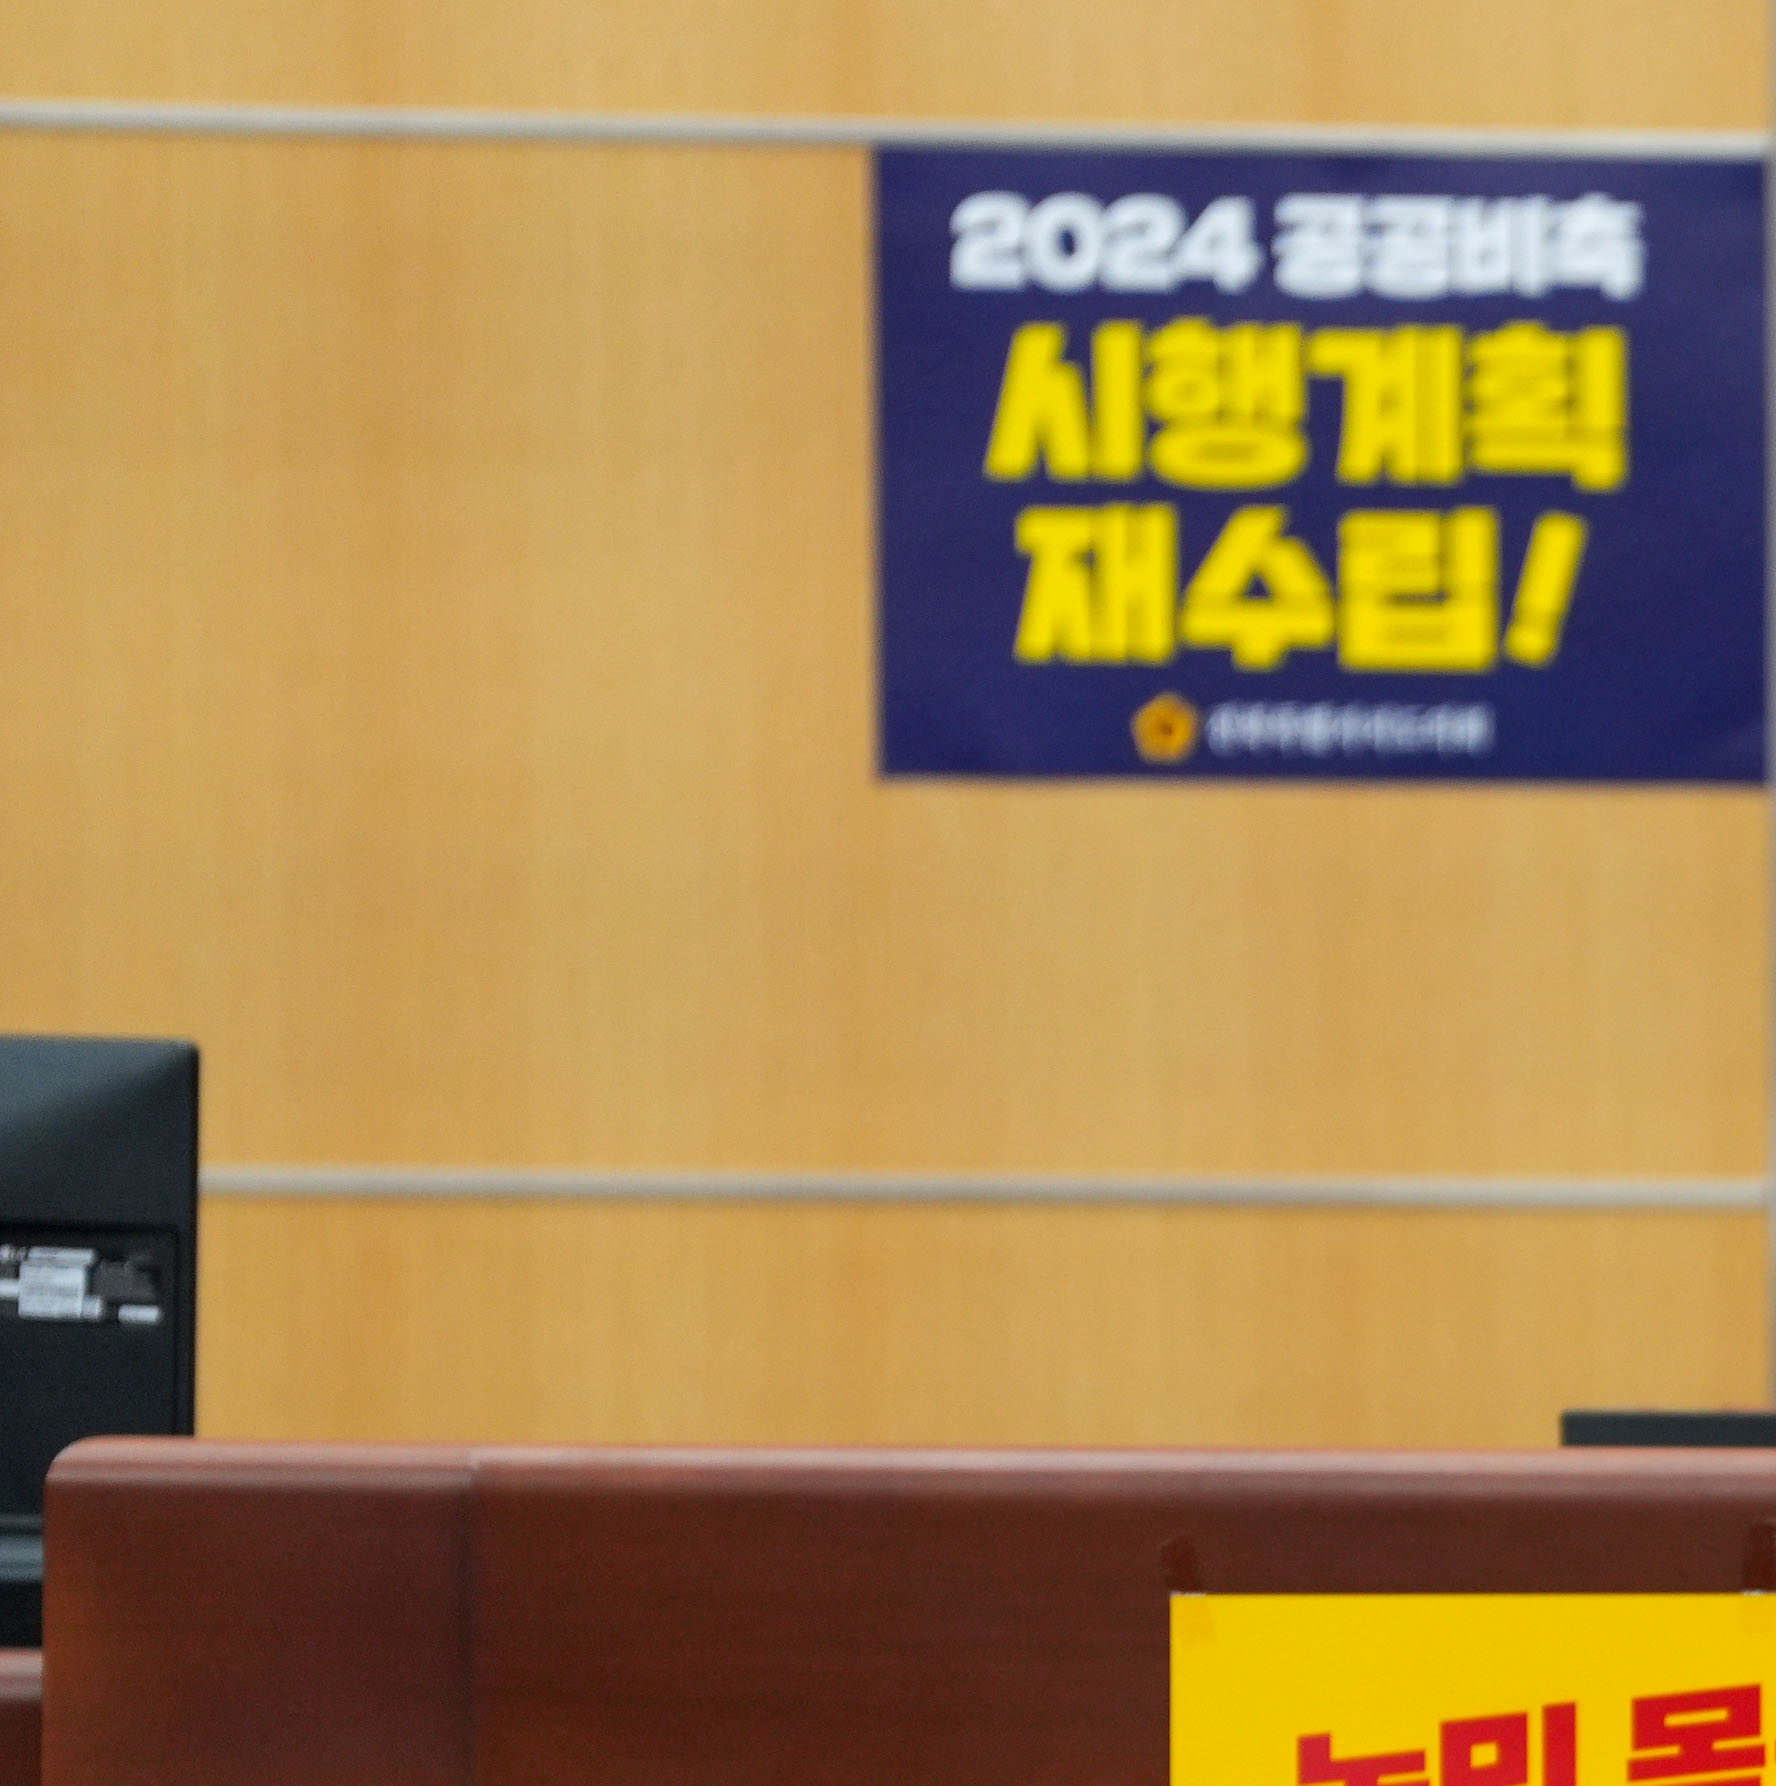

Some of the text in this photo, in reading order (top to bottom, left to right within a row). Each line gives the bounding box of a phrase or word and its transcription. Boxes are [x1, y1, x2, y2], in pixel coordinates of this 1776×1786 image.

[952, 194, 1642, 298] 2024 공공비축
[987, 320, 1624, 489] 시행계획
[1016, 505, 1583, 670] 재수립!
